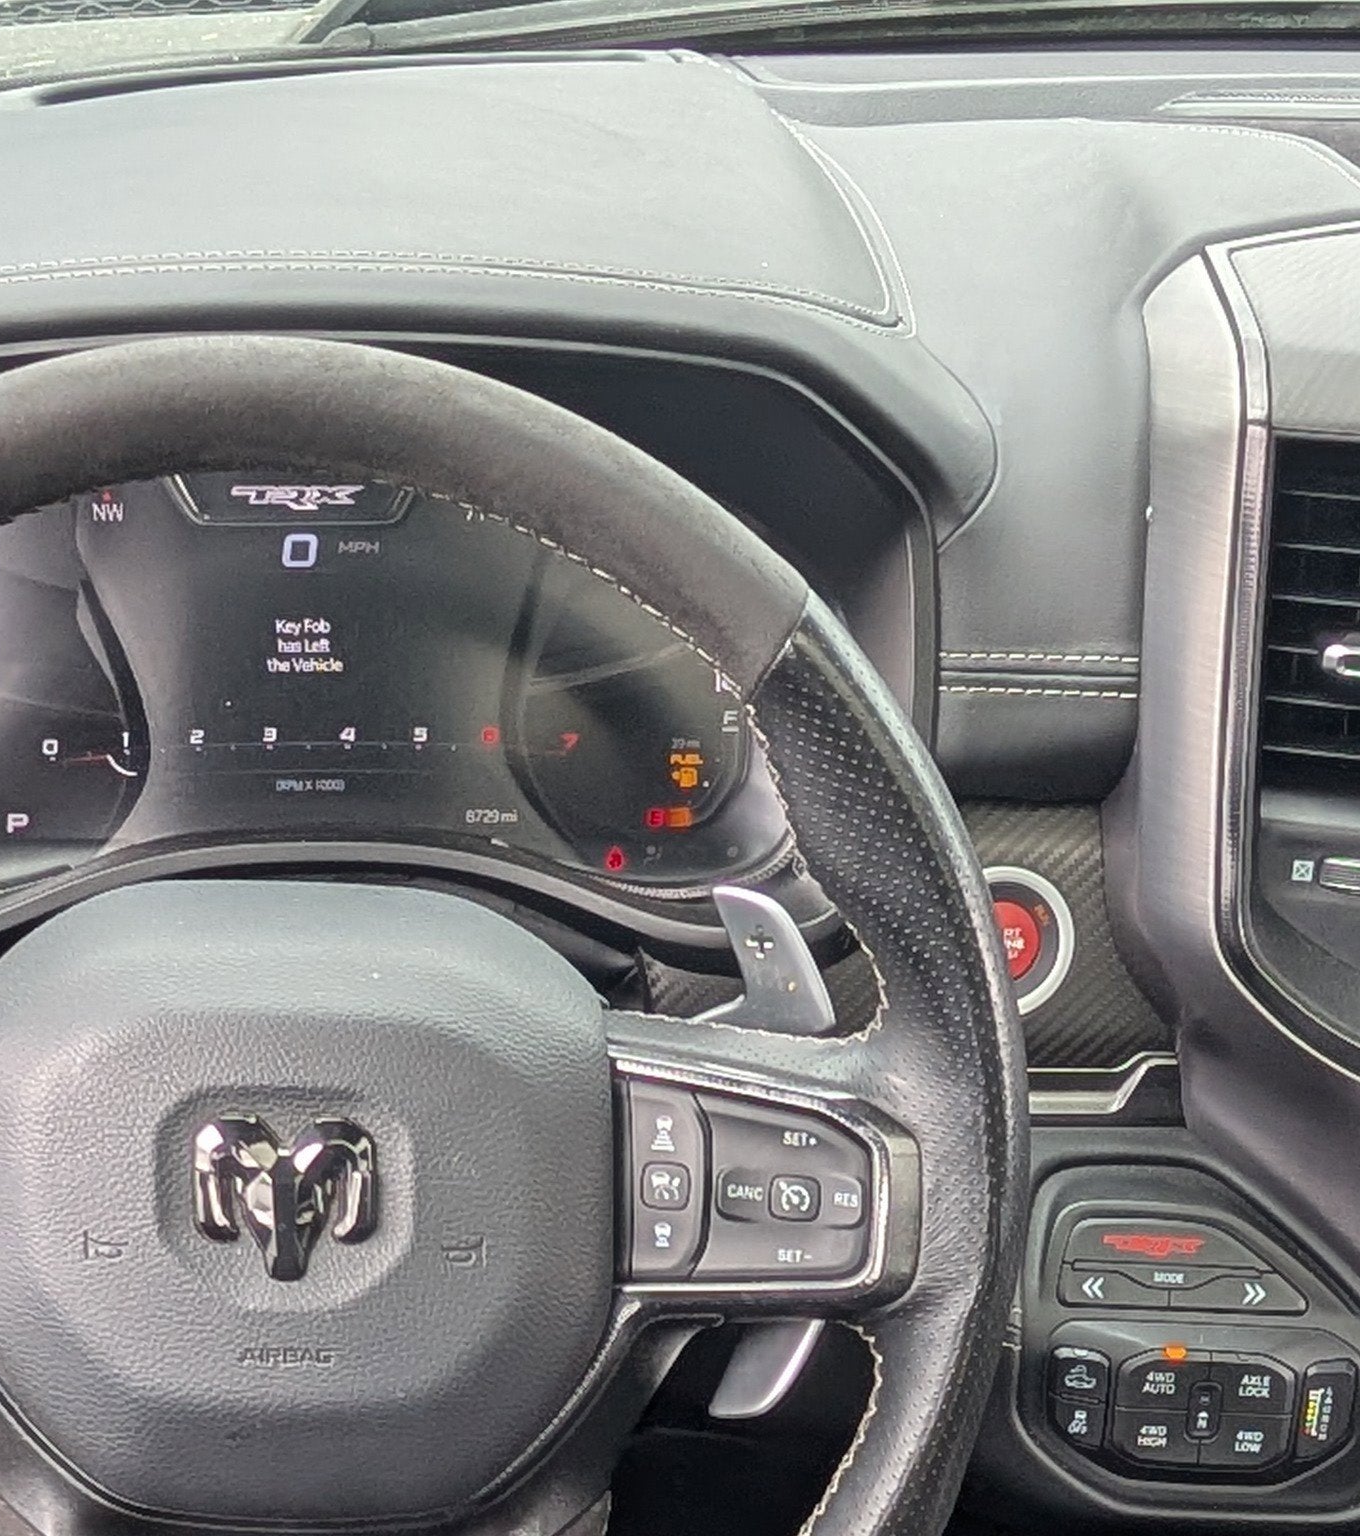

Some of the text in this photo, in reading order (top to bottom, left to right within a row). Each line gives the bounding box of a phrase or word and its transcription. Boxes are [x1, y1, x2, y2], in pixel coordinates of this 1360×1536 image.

[231, 485, 364, 511] TRX
[92, 502, 124, 523] NW
[281, 532, 380, 568] 0 MPH
[275, 617, 331, 637] Key Fob
[277, 638, 331, 653] has Left
[267, 657, 343, 673] the Vehicle
[190, 729, 205, 744] 2
[262, 727, 278, 743] 3
[340, 727, 356, 743] 4
[412, 728, 428, 743] 5
[559, 731, 581, 750] 7
[669, 753, 704, 765] FUEL
[6, 812, 30, 834] P
[500, 809, 519, 823] mi
[727, 1184, 763, 1201] CANC
[833, 1192, 858, 1208] RES
[1153, 1271, 1184, 1284] MODE
[241, 1347, 336, 1367] AIRBAG
[1146, 1371, 1176, 1383] 4WD
[1240, 1374, 1272, 1387] AXLE
[1142, 1383, 1176, 1395] AUTO
[1238, 1386, 1271, 1399] LOCK
[1139, 1425, 1168, 1437] 4WD
[1236, 1430, 1265, 1442] 4WD
[1137, 1435, 1168, 1448] HIGH
[1234, 1441, 1263, 1454] LOW
